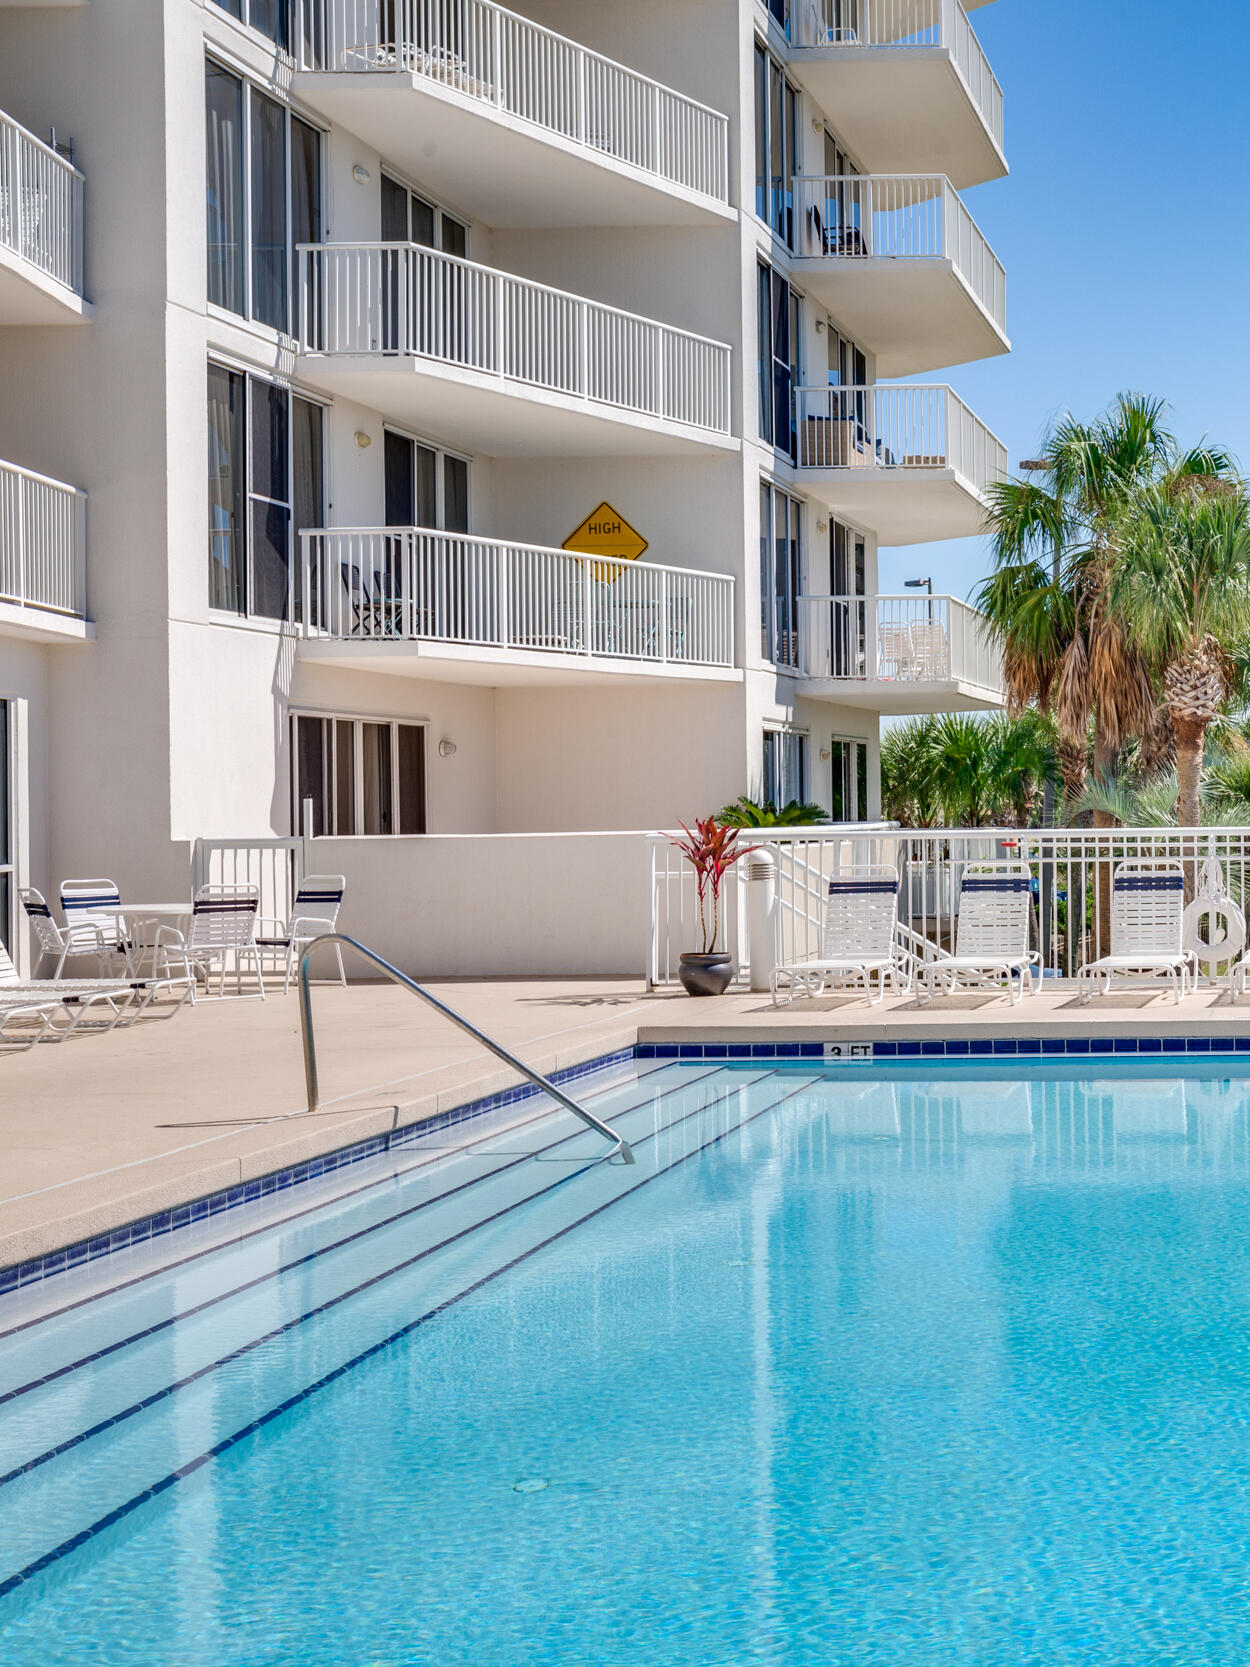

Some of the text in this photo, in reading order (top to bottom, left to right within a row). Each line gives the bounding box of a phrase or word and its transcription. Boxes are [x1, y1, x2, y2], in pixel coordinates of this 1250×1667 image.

[588, 522, 621, 535] HIGH
[831, 1045, 870, 1056] 3 FT
